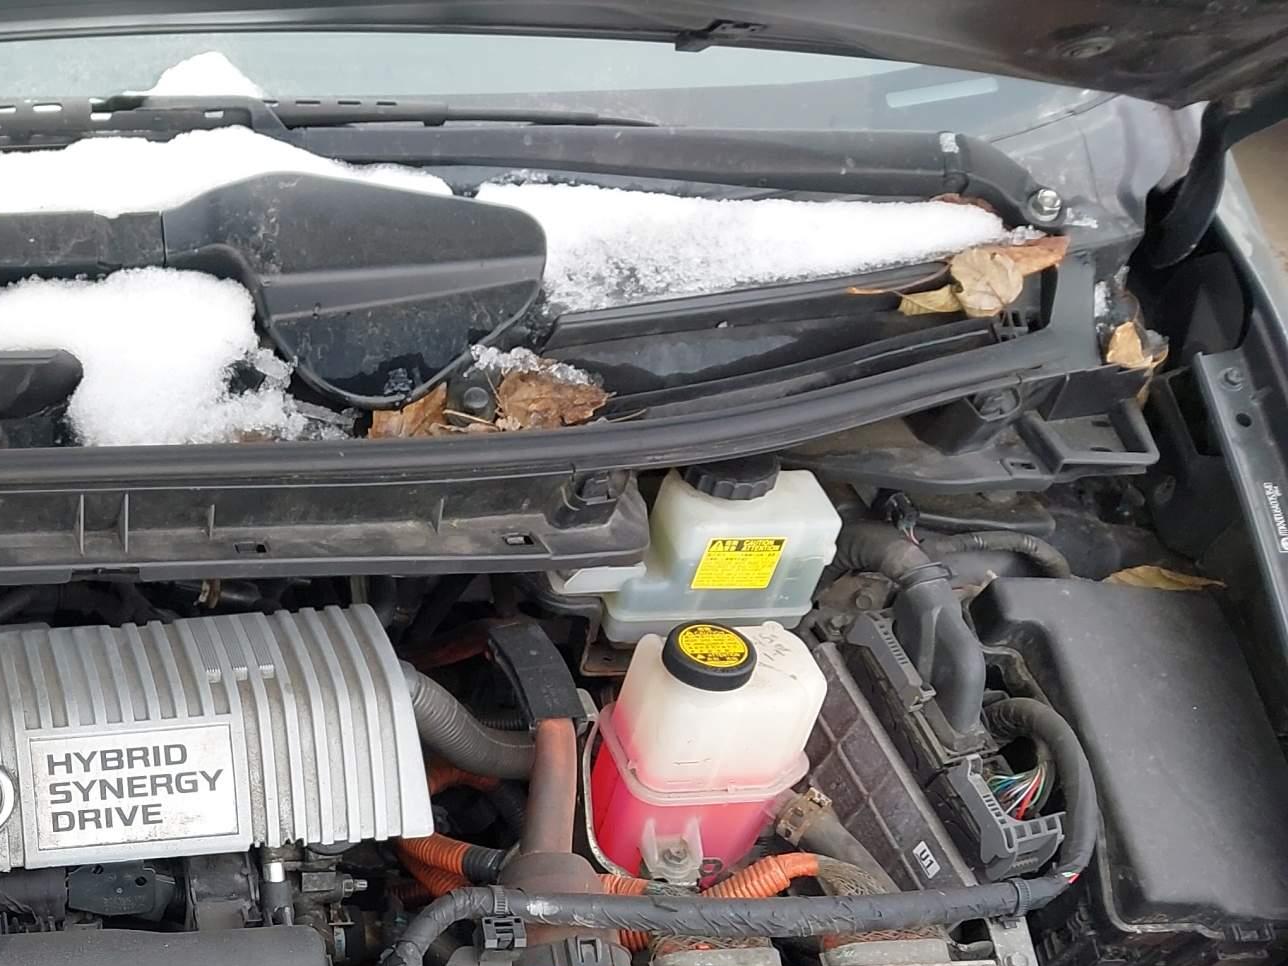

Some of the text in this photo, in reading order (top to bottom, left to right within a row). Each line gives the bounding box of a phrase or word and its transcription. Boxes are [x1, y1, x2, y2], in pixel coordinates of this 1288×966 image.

[47, 744, 187, 775] HYBRID
[49, 769, 223, 804] SYNERGY
[52, 804, 163, 832] DRIVE
[920, 849, 934, 868] U1
